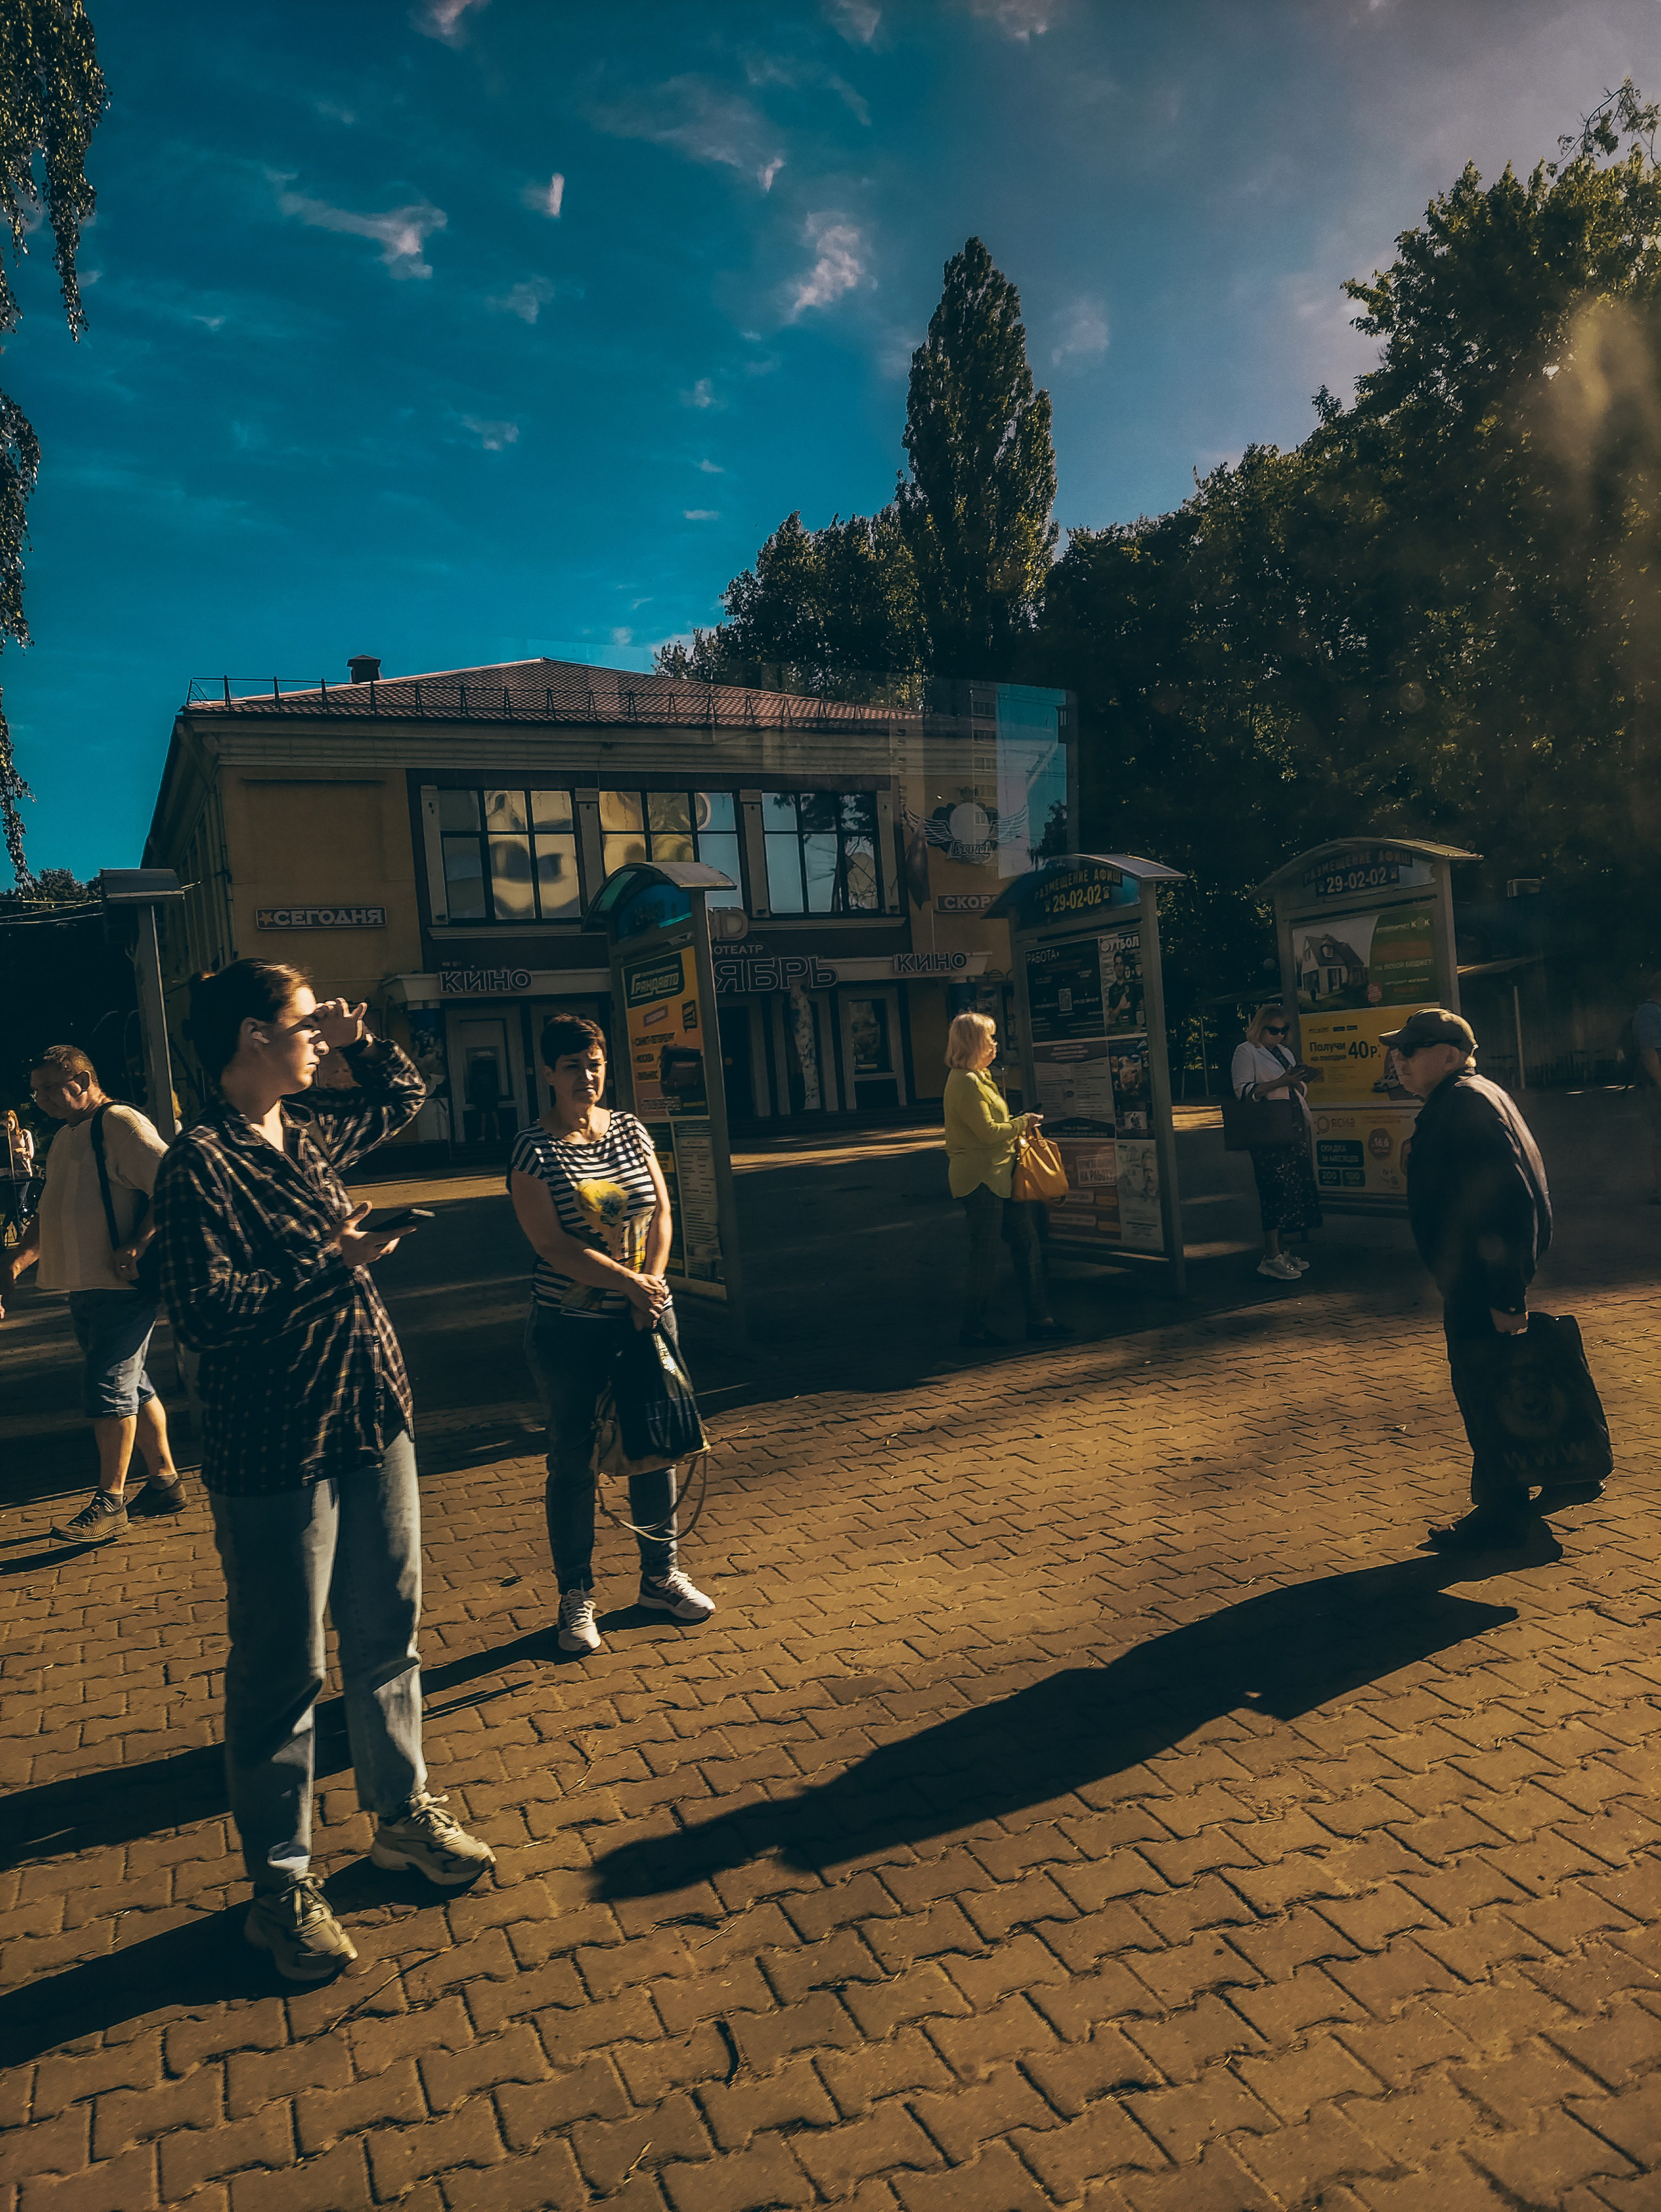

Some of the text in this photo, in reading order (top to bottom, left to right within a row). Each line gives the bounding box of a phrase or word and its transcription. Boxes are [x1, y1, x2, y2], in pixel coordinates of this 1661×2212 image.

[1303, 851, 1412, 884] РАЗМЕЩЕНИЕ АФИШ
[1034, 869, 1122, 901] РАЗМЕЩЕНИЕ АФИШ
[1326, 866, 1387, 893] 29-02-02
[944, 895, 998, 910] СКОР
[1052, 884, 1102, 913] 29-02-02
[272, 908, 383, 927] СЕГОДНЯ
[708, 906, 749, 942] D
[713, 944, 764, 955] ОТЕАТР
[1100, 935, 1140, 953] ФУТБОЛ
[893, 952, 967, 973] КИНО
[439, 969, 533, 993] КИНО
[714, 956, 838, 993] ЯБРЬ
[1309, 1041, 1346, 1052] Получи
[1322, 1171, 1337, 1180] 200
